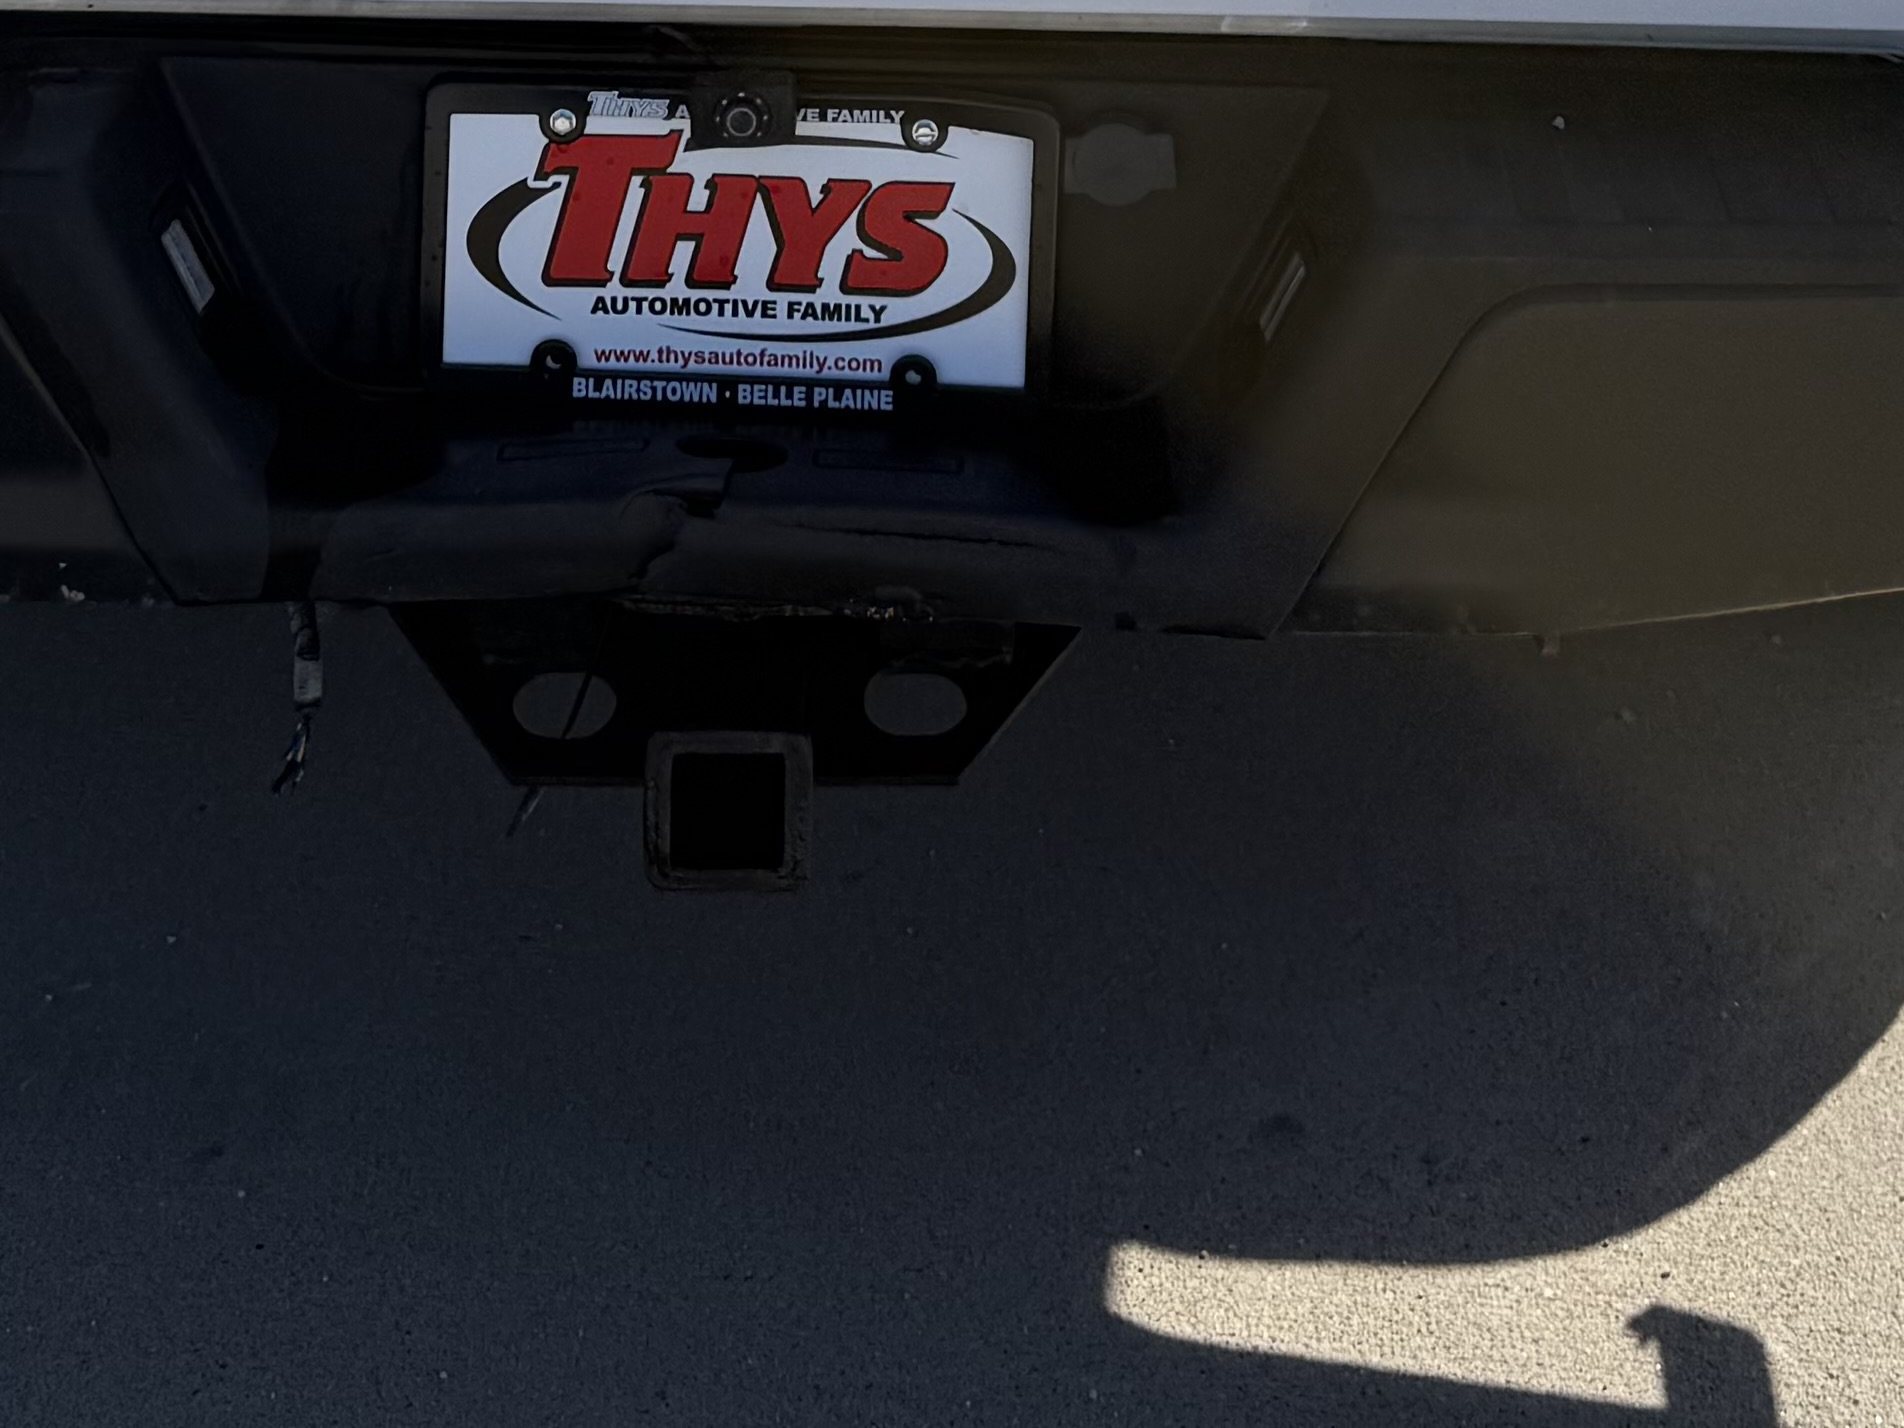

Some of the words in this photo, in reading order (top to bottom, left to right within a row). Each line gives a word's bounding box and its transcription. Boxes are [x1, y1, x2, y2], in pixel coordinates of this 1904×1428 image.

[587, 90, 670, 119] THYS
[826, 109, 906, 124] FAMILY
[528, 128, 956, 298] THYS
[590, 295, 778, 320] AUTOMOTIVE
[785, 300, 888, 324] FAMILY
[593, 345, 883, 374] www.thysautofamily.com
[571, 376, 718, 404] BLAIRSTOWN
[737, 383, 807, 407] BELLE
[813, 386, 894, 411] PLAINE
